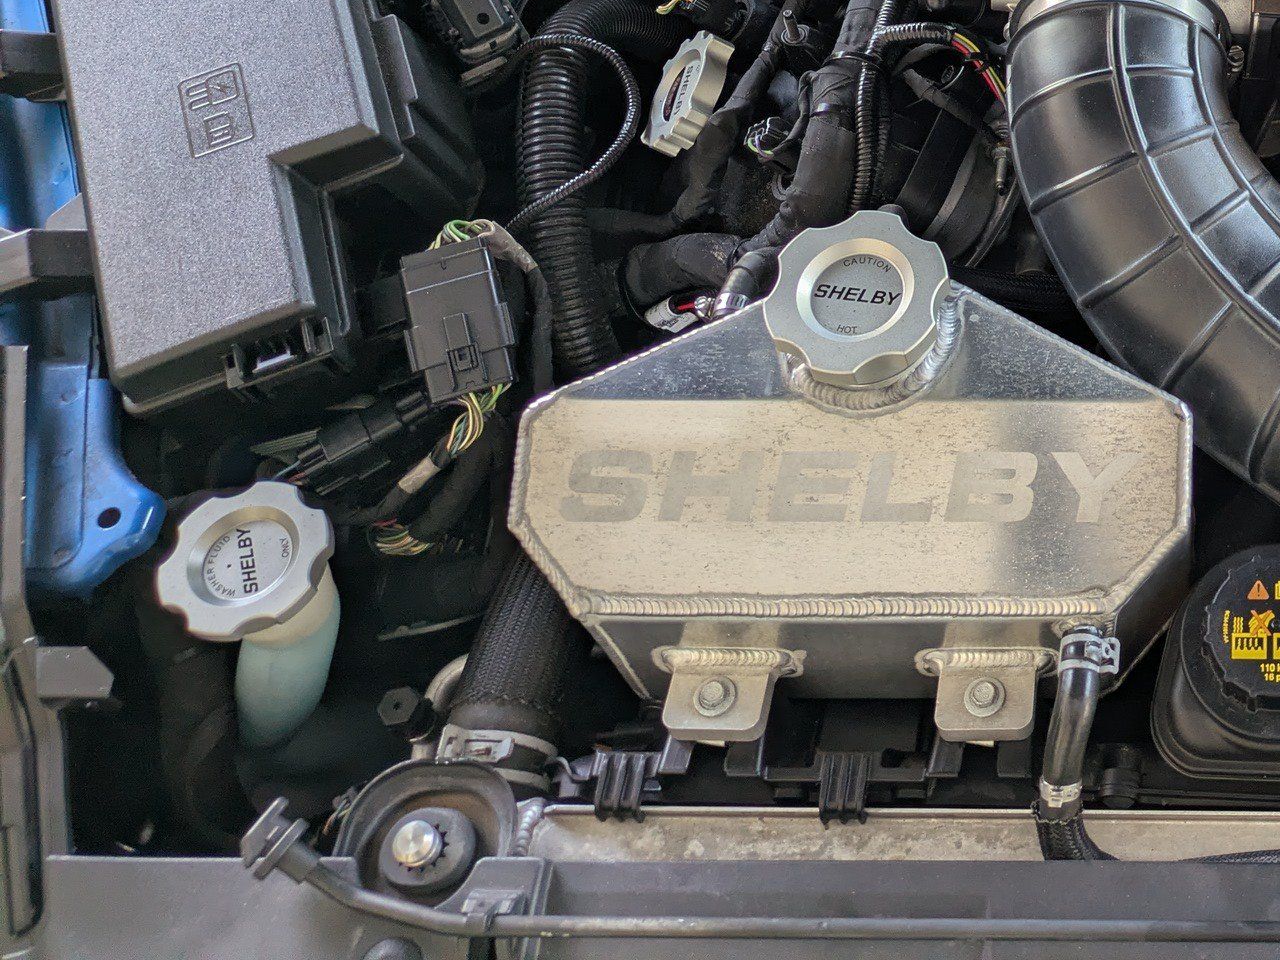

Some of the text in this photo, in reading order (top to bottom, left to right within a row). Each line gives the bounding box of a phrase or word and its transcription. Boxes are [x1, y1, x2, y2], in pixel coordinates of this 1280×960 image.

[843, 256, 892, 273] CAUTION
[814, 283, 902, 306] SHELBY
[836, 324, 858, 334] HOT
[559, 450, 1143, 523] SHELBY
[279, 537, 290, 558] ONLY
[206, 535, 236, 597] WASHER FLUID
[236, 528, 259, 594] SHELBY
[1260, 663, 1275, 672] 110
[1264, 673, 1275, 681] 16
